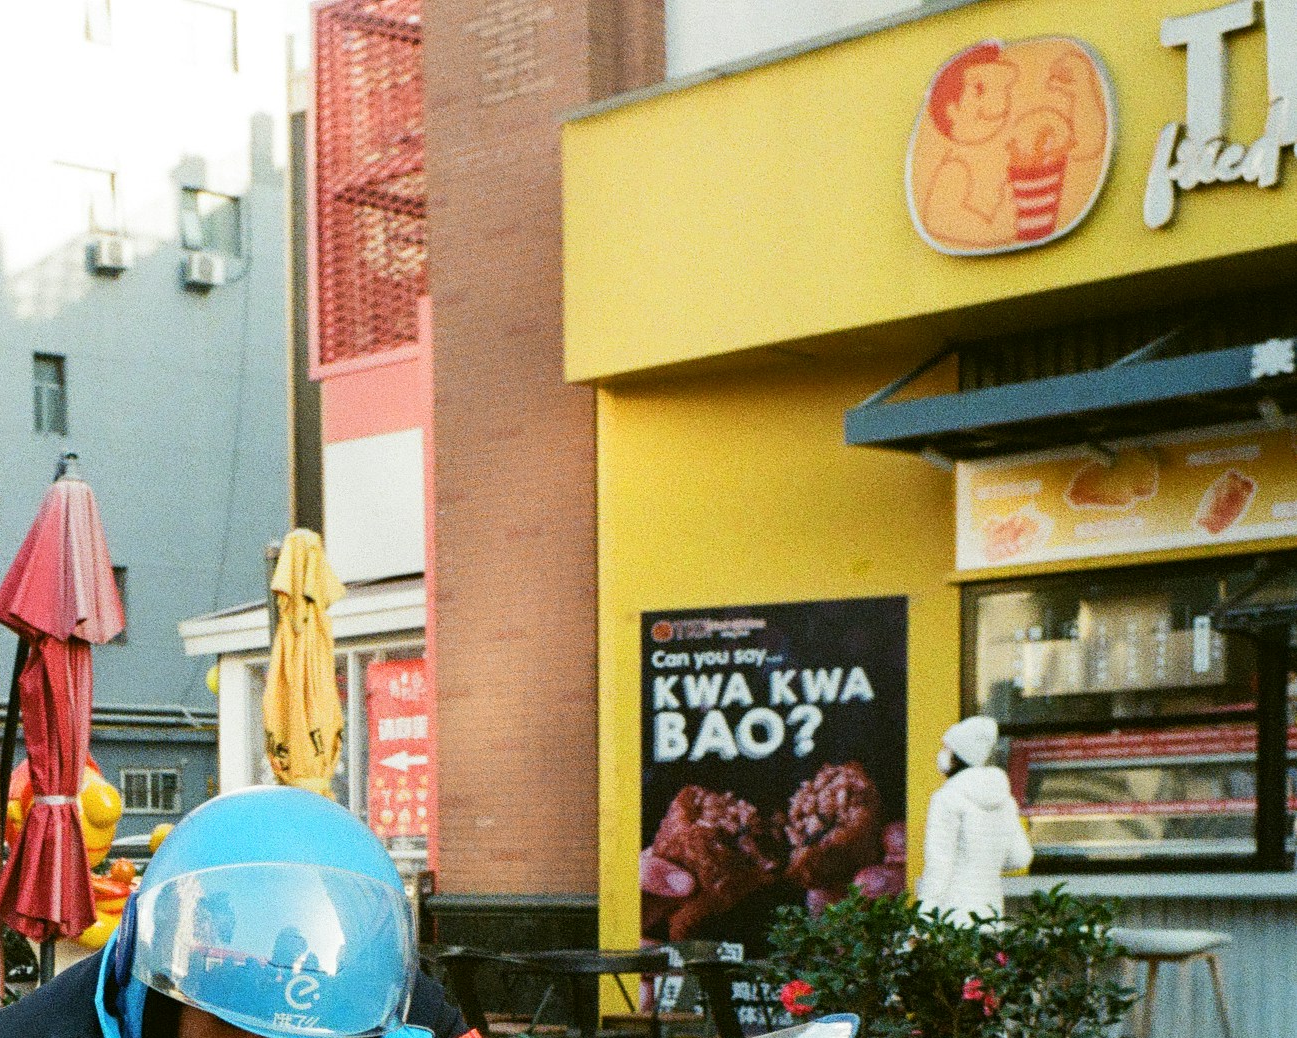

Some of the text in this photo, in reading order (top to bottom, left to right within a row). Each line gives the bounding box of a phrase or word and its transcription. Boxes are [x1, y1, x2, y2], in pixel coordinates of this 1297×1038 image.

[1143, 97, 1280, 229] fried
[652, 650, 690, 669] Can
[693, 651, 730, 671] you
[653, 666, 875, 709] KWA KWA
[653, 704, 823, 762] BAO?
